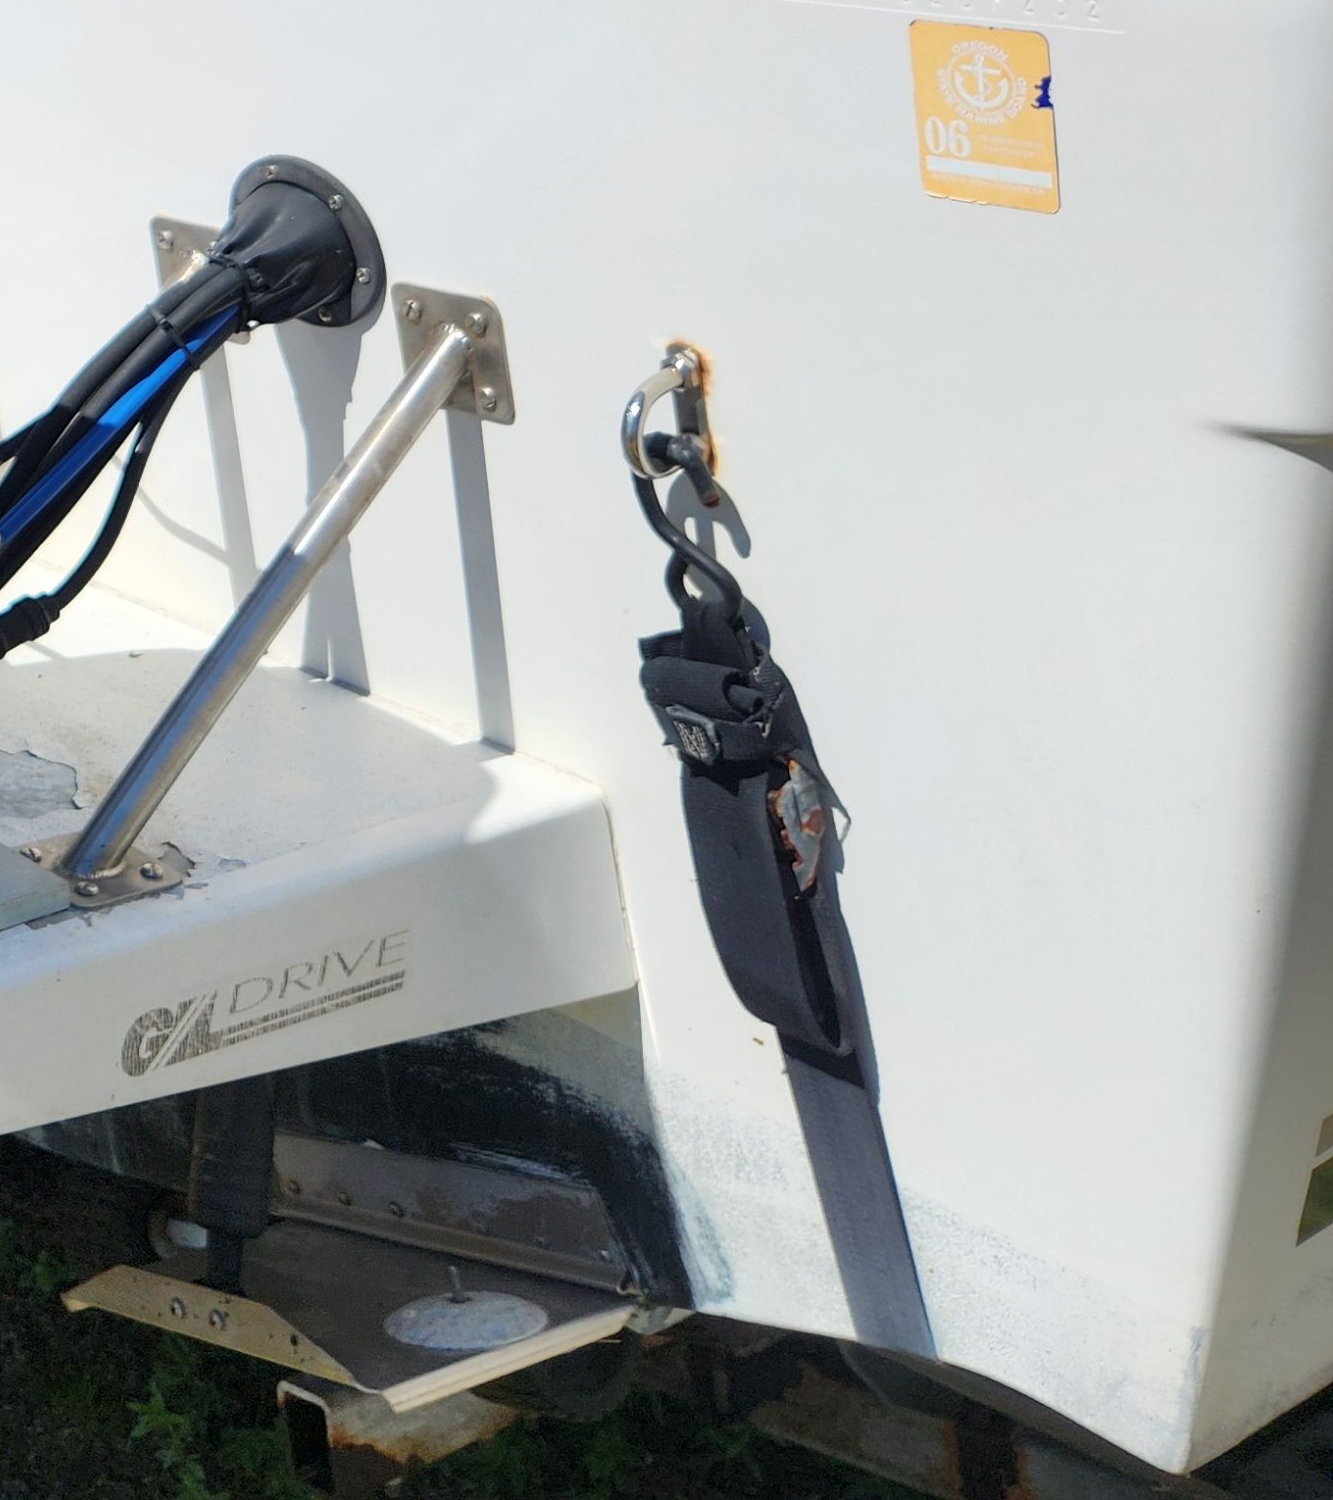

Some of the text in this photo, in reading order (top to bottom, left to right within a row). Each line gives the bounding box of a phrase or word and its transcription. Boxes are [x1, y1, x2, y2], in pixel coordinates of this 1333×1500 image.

[951, 40, 1008, 61] OREGON
[924, 116, 972, 158] 06
[229, 929, 411, 1016] DRIVE
